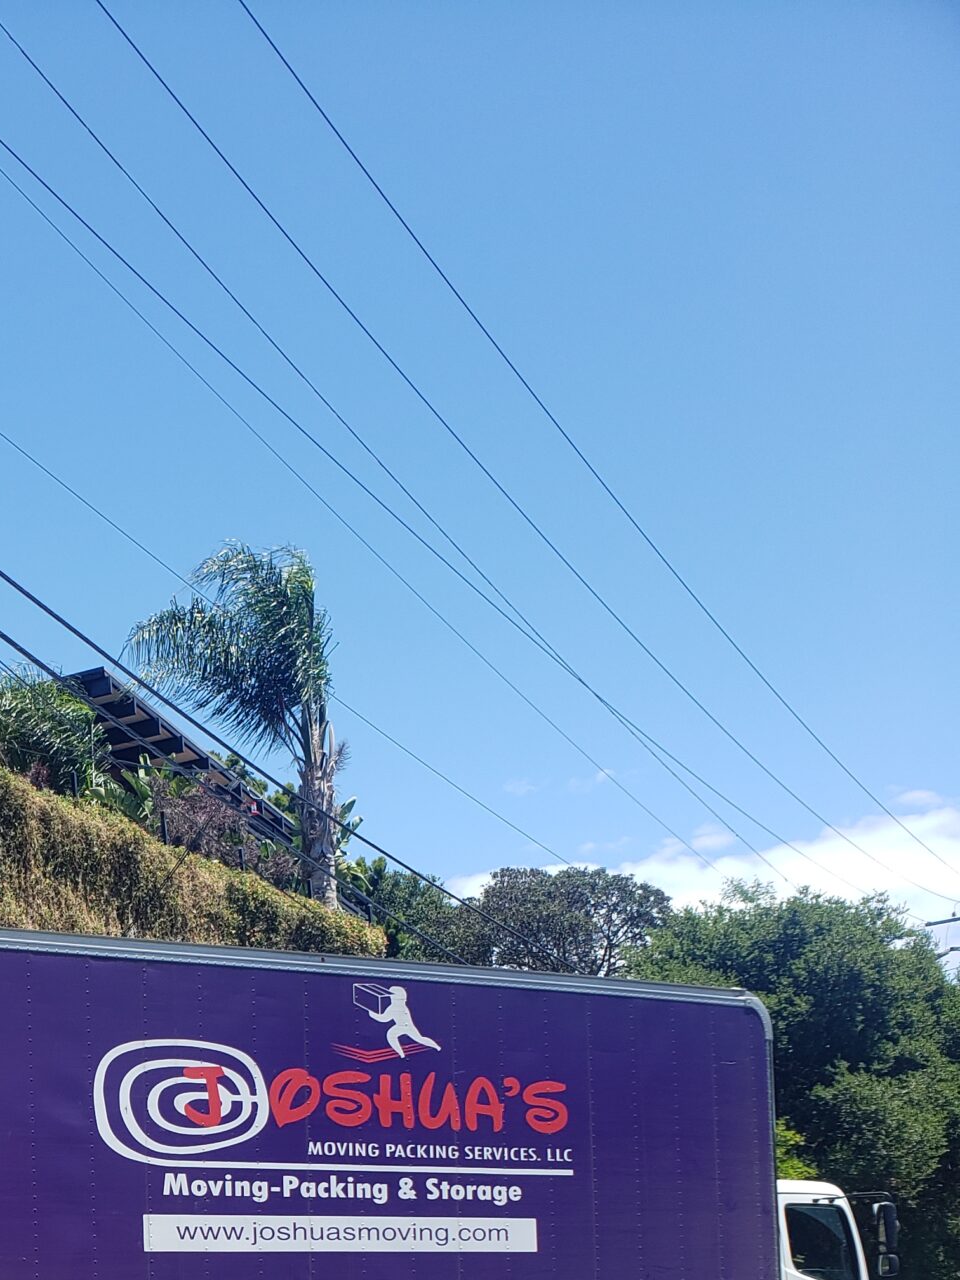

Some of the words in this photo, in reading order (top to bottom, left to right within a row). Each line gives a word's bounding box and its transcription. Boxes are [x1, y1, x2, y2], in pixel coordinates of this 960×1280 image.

[182, 1066, 569, 1134] JOSHUA'S
[307, 1141, 380, 1158] MOVING
[385, 1143, 460, 1160] PACKING
[547, 1148, 573, 1162] LLC
[162, 1172, 389, 1206] Moving-Packing
[397, 1177, 417, 1200] &
[425, 1177, 523, 1206] Storage
[176, 1221, 510, 1246] www.joshuasmoving.com
